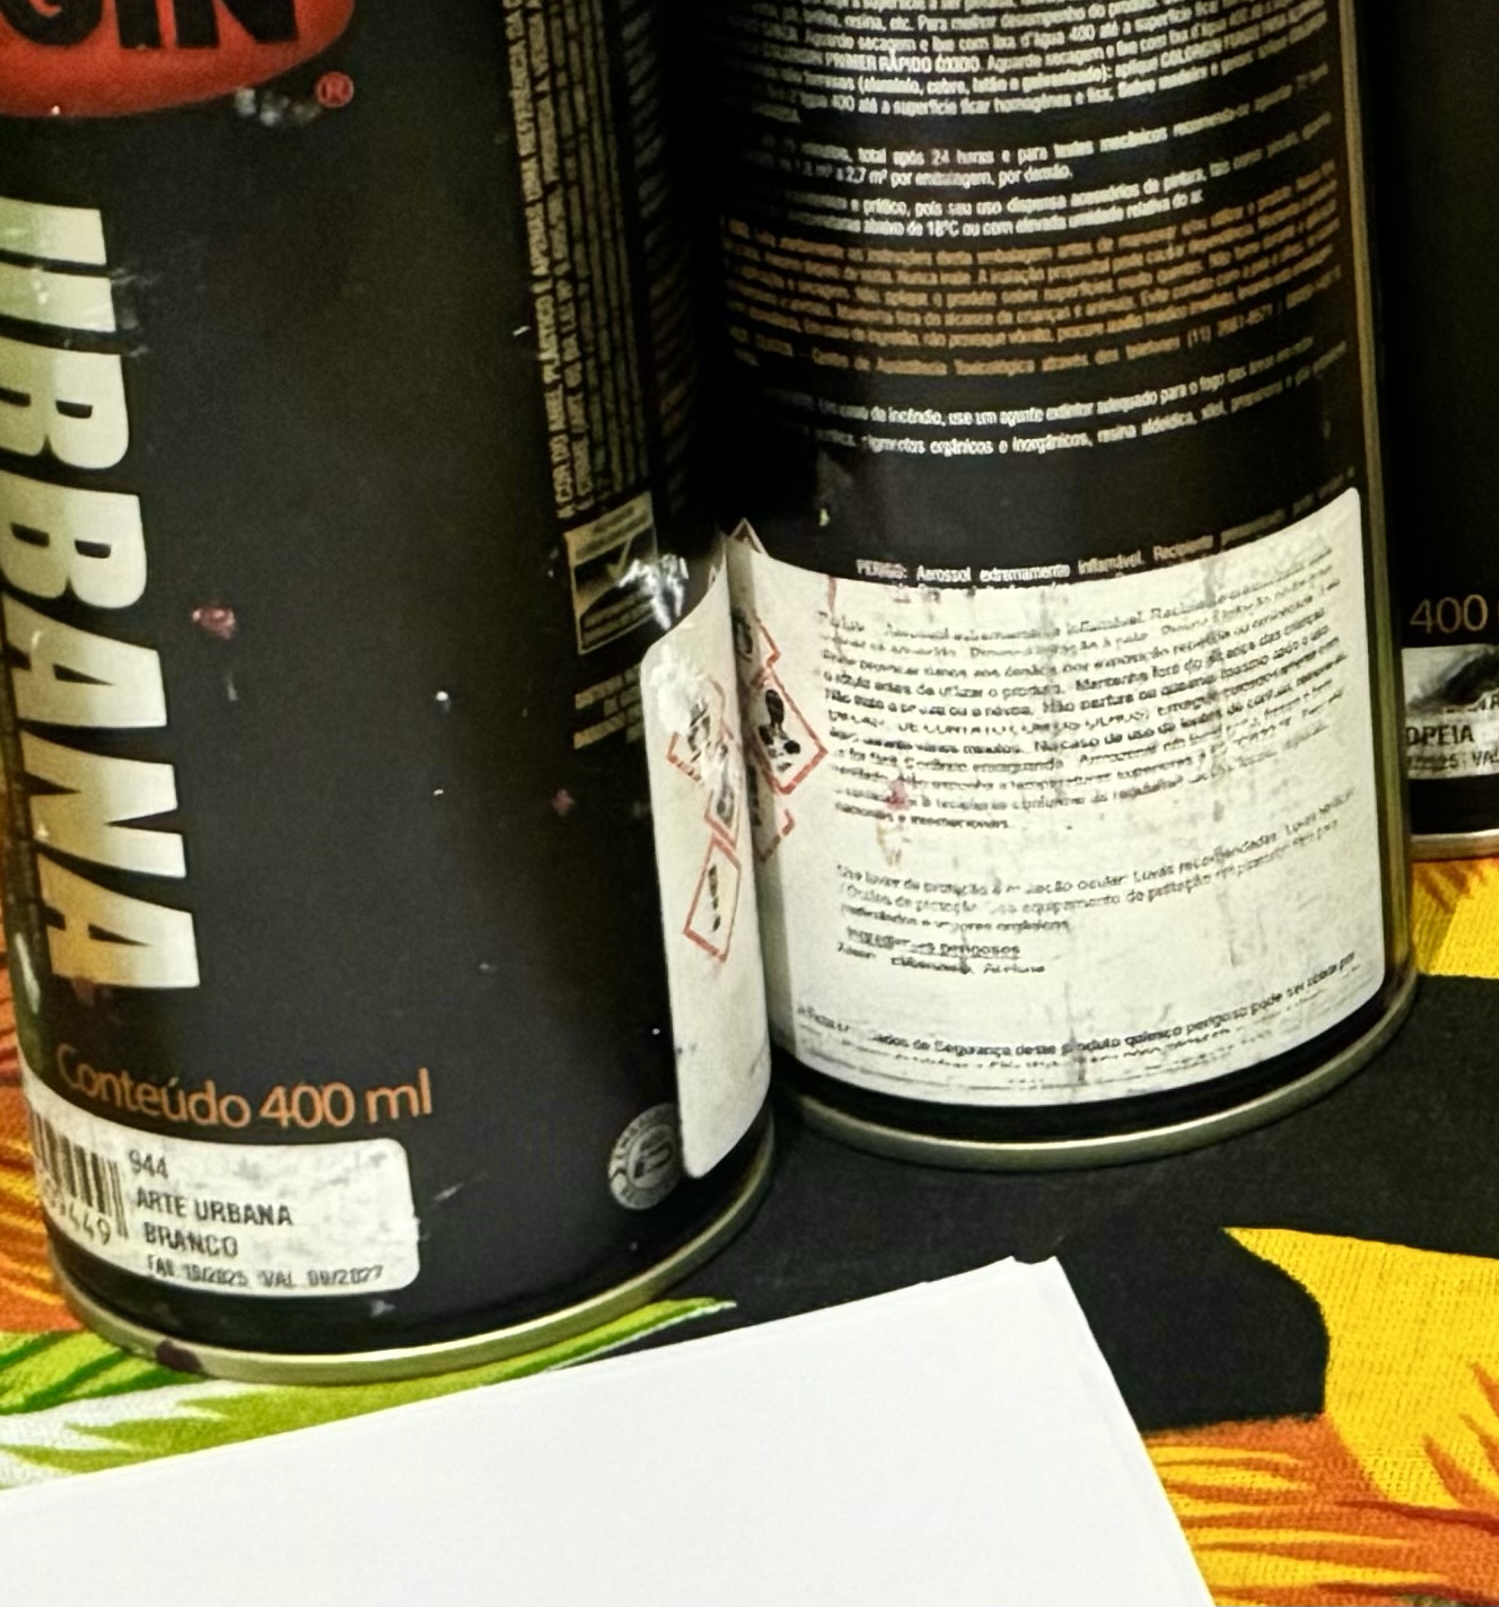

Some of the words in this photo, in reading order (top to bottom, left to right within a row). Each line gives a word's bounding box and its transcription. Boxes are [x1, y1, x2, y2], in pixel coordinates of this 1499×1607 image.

[1408, 593, 1489, 634] 400
[56, 1043, 252, 1128] Conteúdo
[259, 1081, 356, 1129] 400
[365, 1067, 433, 1124] ml
[128, 1148, 170, 1179] 944
[136, 1186, 187, 1217] ARTE
[194, 1198, 294, 1227] URBANA
[143, 1220, 239, 1258] BRANCO
